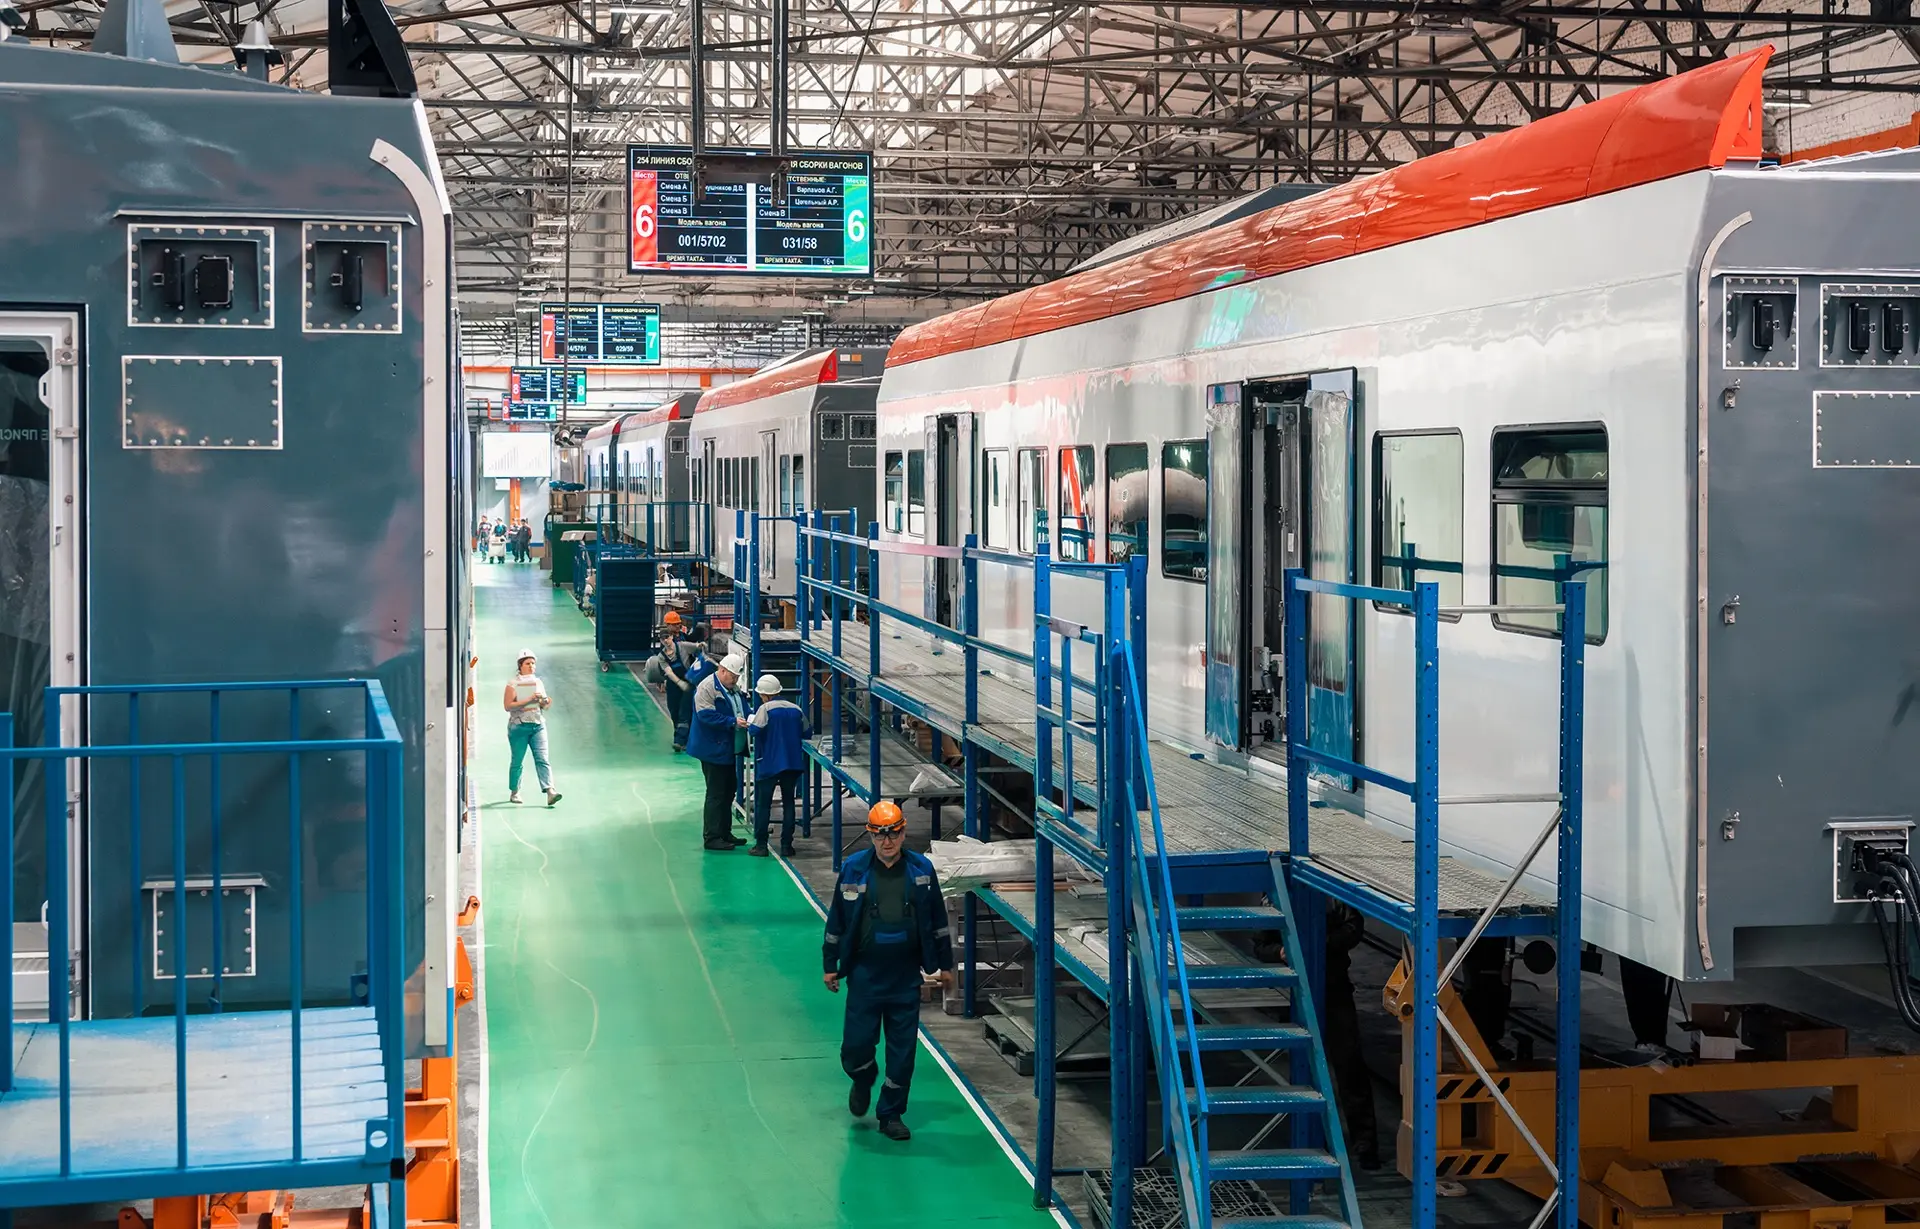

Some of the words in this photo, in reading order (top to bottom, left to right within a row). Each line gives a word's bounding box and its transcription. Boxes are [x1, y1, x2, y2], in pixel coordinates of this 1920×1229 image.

[637, 156, 649, 164] 254
[650, 157, 675, 165] ЛИНИЯ
[799, 161, 828, 169] СБОРКИ
[829, 162, 864, 170] ВАГОНОВ
[660, 182, 681, 190] Смена
[759, 185, 772, 193] Сме
[660, 195, 681, 203] Смена
[759, 209, 779, 217] Смена
[635, 204, 654, 238] 6
[678, 218, 704, 226] Модель
[776, 221, 802, 229] Модель
[847, 209, 865, 242] 6
[678, 234, 726, 248] 001/5702
[782, 237, 818, 250] 031/58
[543, 330, 553, 348] 7
[647, 331, 658, 349] 7
[512, 383, 520, 395] 8
[577, 385, 585, 396] 8
